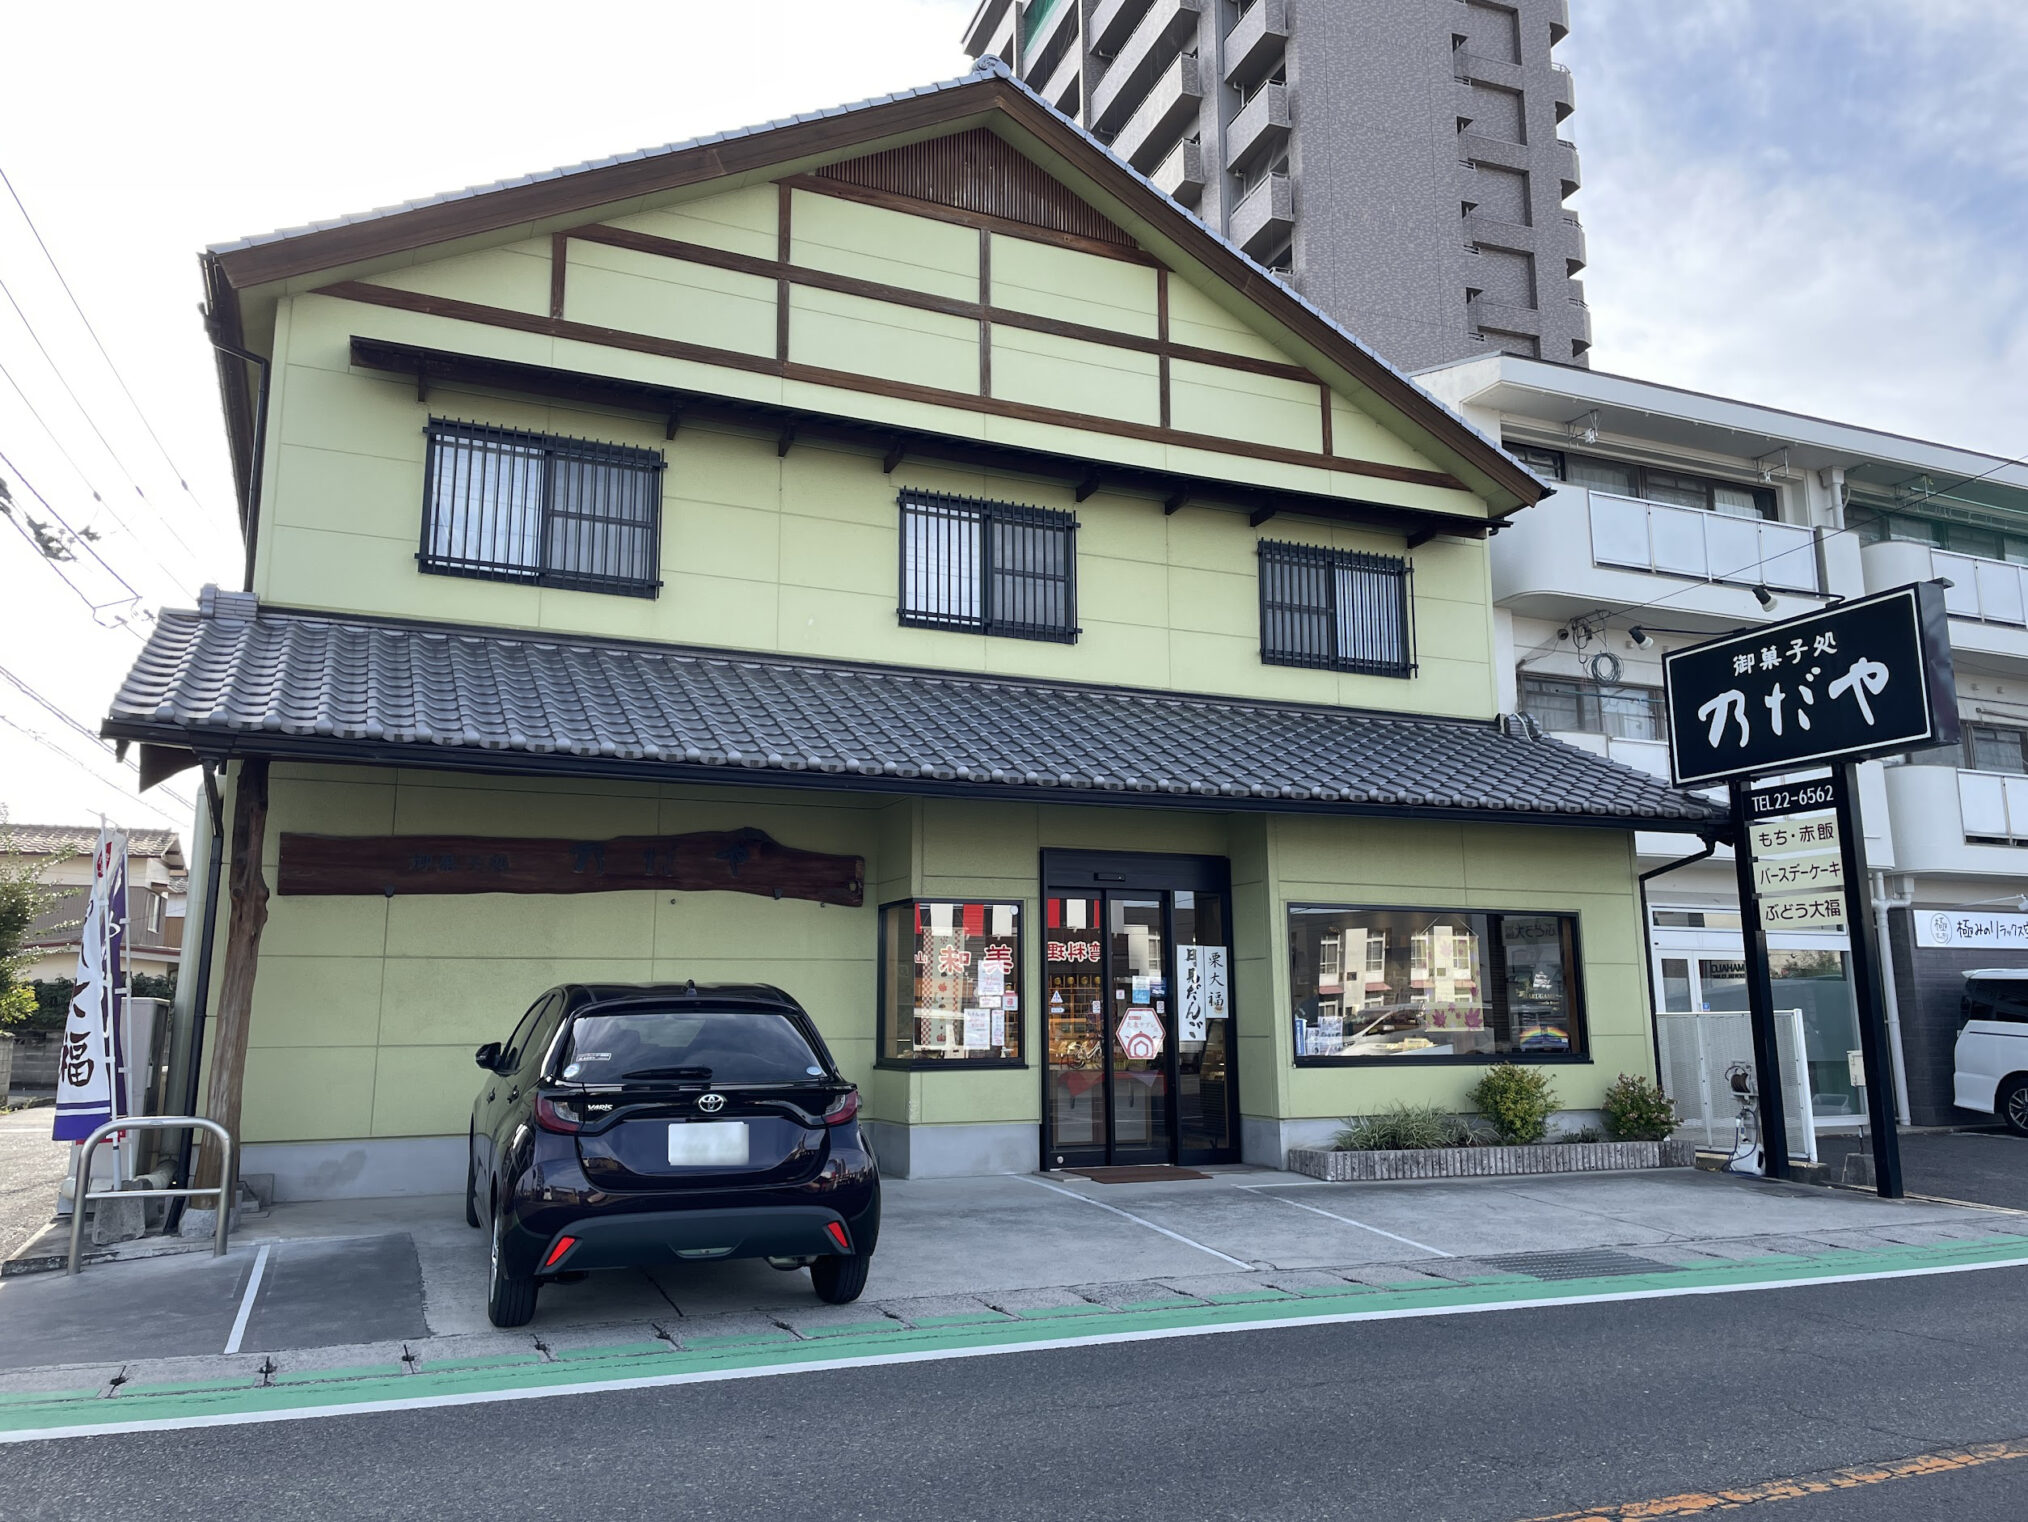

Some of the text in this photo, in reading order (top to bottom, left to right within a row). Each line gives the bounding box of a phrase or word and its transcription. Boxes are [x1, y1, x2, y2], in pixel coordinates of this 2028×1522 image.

[1732, 631, 1838, 677] 御菓子処
[1698, 657, 1890, 749] 乃だや
[1758, 822, 1835, 847] もち・赤飯
[1760, 861, 1841, 885] バースデーケーキ
[1765, 899, 1841, 921] ぶどう大福
